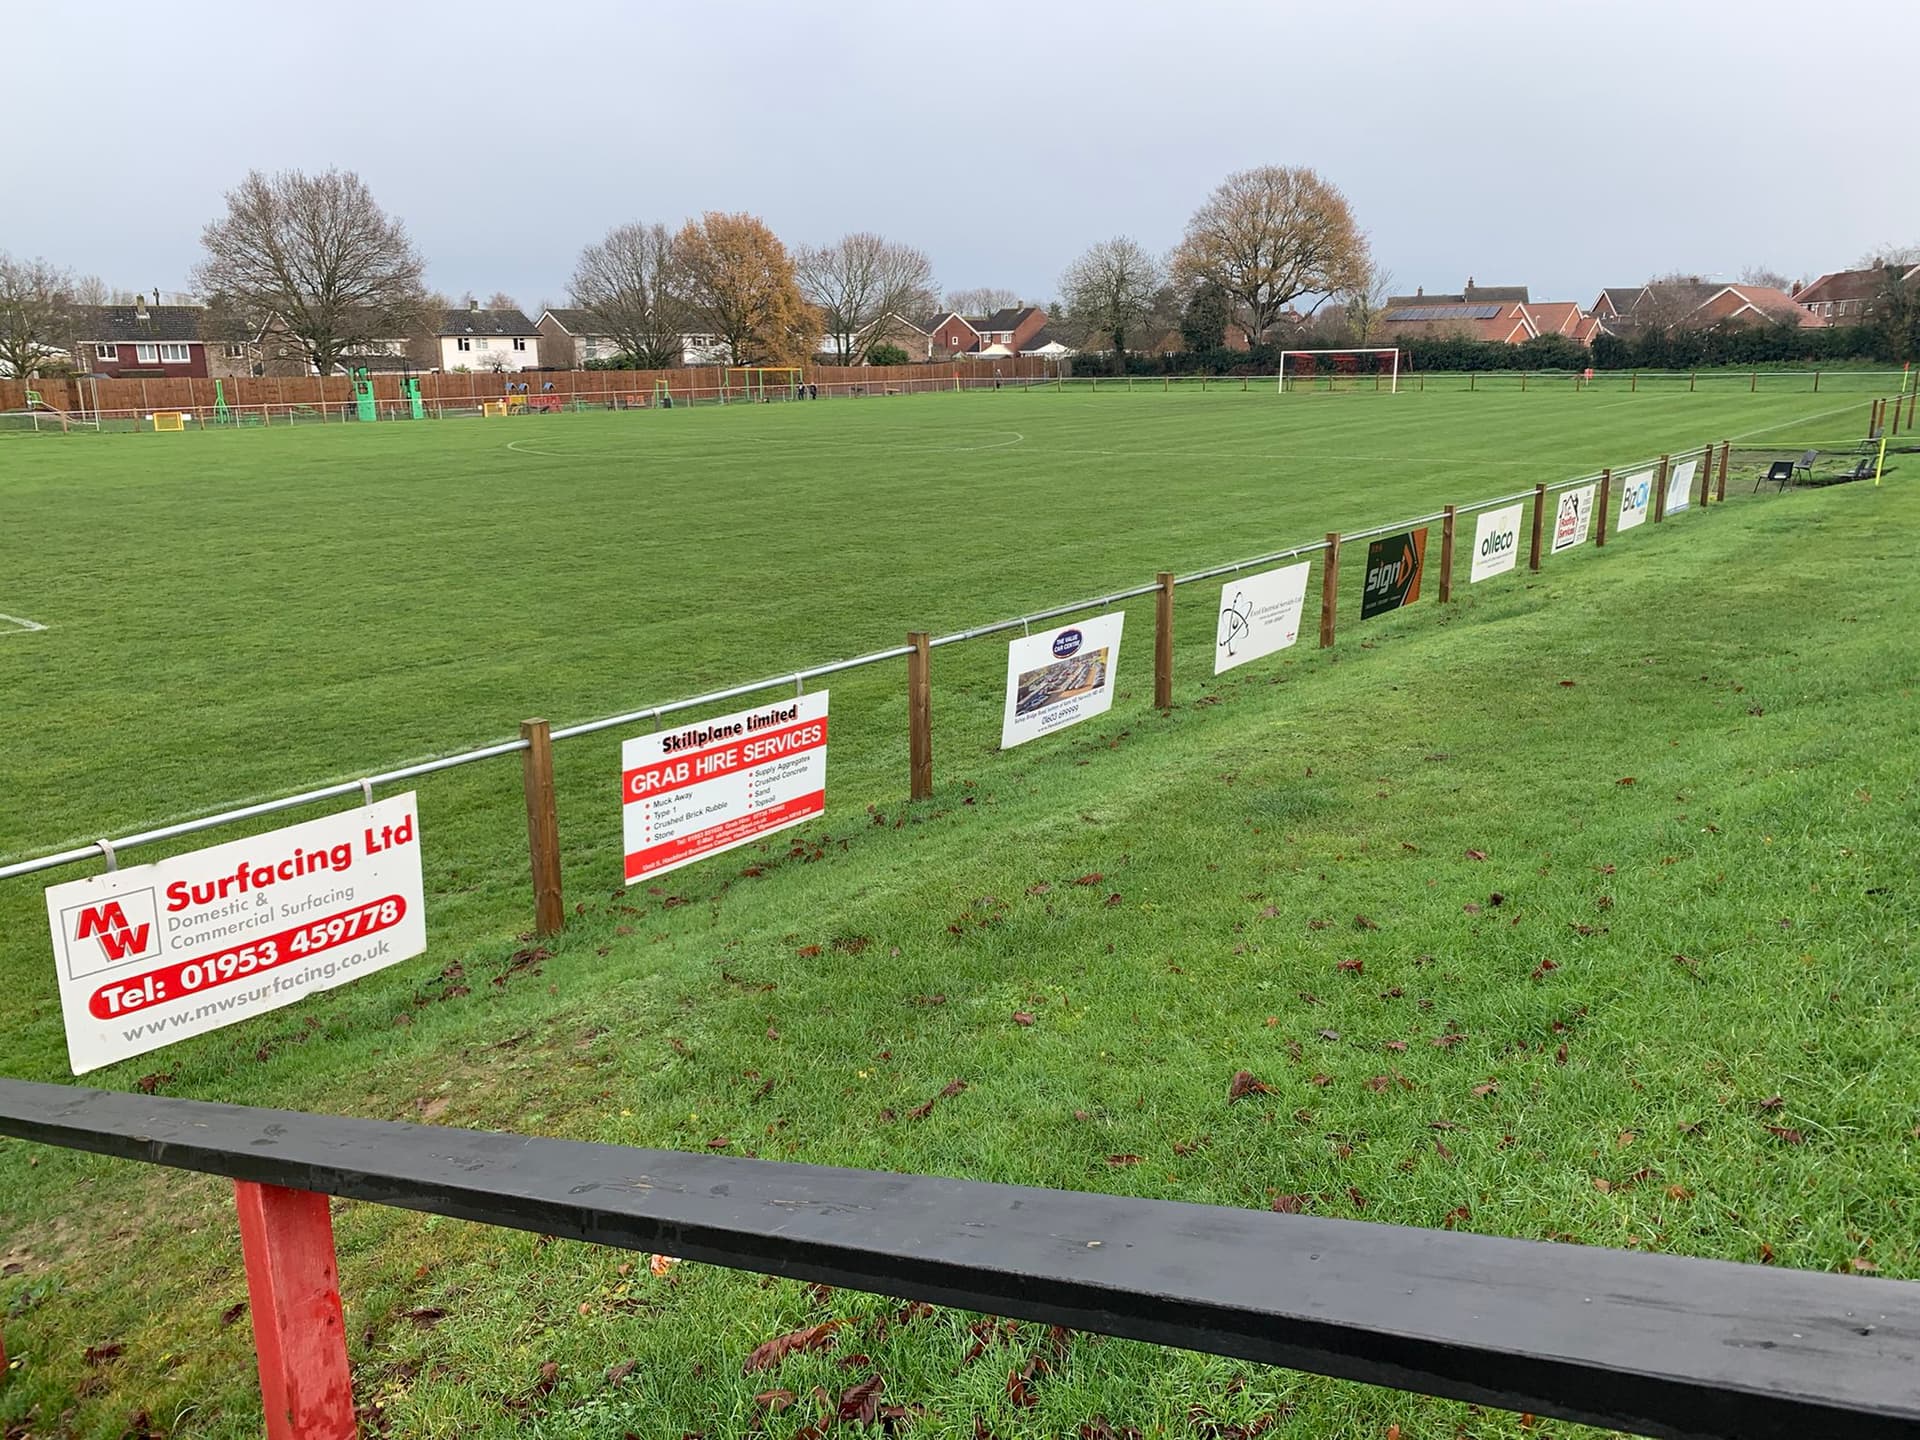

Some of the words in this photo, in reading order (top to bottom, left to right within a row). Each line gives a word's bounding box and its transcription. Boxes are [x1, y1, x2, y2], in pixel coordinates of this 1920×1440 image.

[1481, 530, 1513, 556] olleco
[1054, 645, 1064, 653] CAR
[662, 722, 742, 754] Skillplane
[747, 704, 798, 732] Limited
[630, 762, 689, 794] GRAB
[695, 748, 738, 777] HIRE
[743, 724, 821, 763] SERVICES
[754, 765, 776, 778] Supply
[777, 755, 811, 771] Aggregates
[754, 773, 781, 788] Crushed
[782, 765, 808, 780] Concrete
[653, 798, 672, 809] Muck
[674, 791, 693, 803] Away
[754, 787, 771, 798] Sand
[754, 795, 776, 808] Topsoil
[654, 809, 671, 820] Type
[654, 815, 684, 830] Crushed
[685, 809, 704, 820] Brick
[705, 802, 728, 813] Rubble
[654, 830, 675, 841] Stone
[166, 842, 352, 912] Surfacing
[365, 813, 413, 856] Ltd
[168, 898, 249, 932] Domestic
[256, 892, 269, 906] &
[171, 910, 275, 950] Commercial
[280, 886, 355, 919] Surfacing
[101, 980, 166, 1014] Tel:
[180, 941, 279, 990] 01953
[290, 900, 399, 954] 459778
[122, 940, 390, 1042] www.mwsurfacing.co.uk
